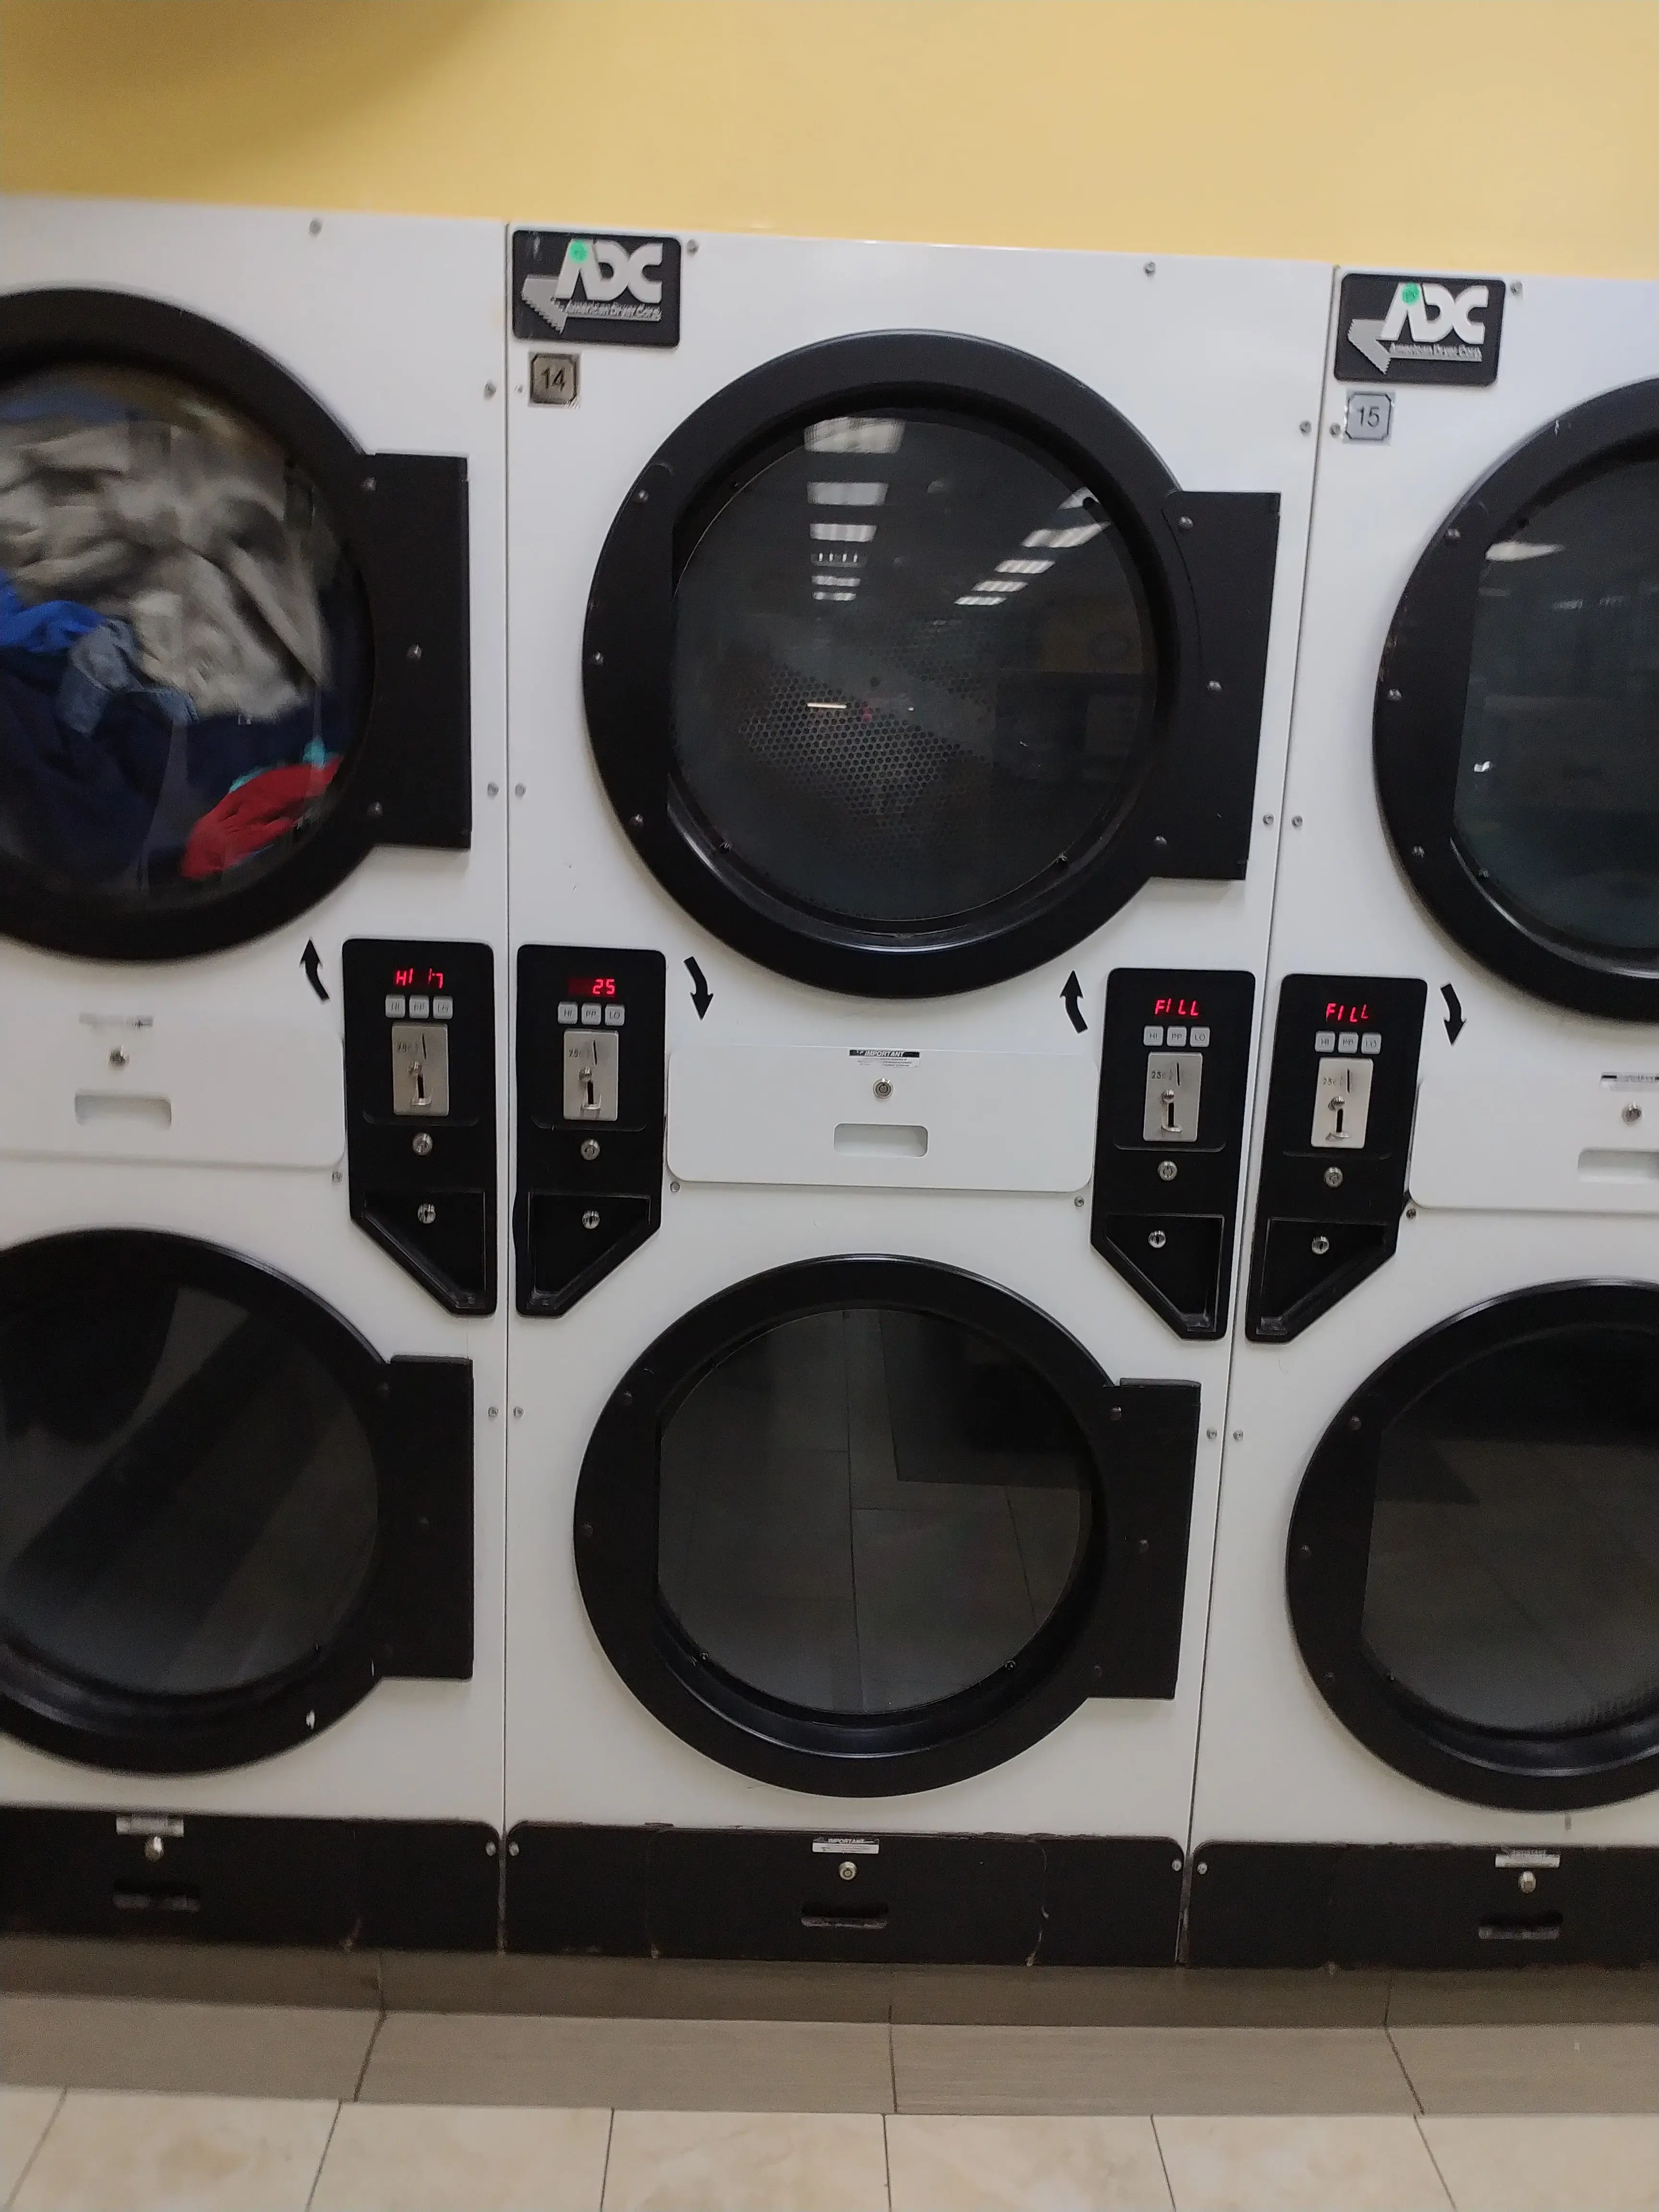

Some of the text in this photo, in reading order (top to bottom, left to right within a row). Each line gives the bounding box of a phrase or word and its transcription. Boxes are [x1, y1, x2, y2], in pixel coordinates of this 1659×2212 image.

[554, 238, 663, 303] ADC
[1381, 282, 1489, 345] ADC
[541, 367, 567, 392] 14
[1357, 405, 1380, 428] 15
[396, 968, 413, 986] HI
[592, 978, 615, 995] 25
[1154, 998, 1199, 1016] FILL
[1325, 1002, 1369, 1022] FILL
